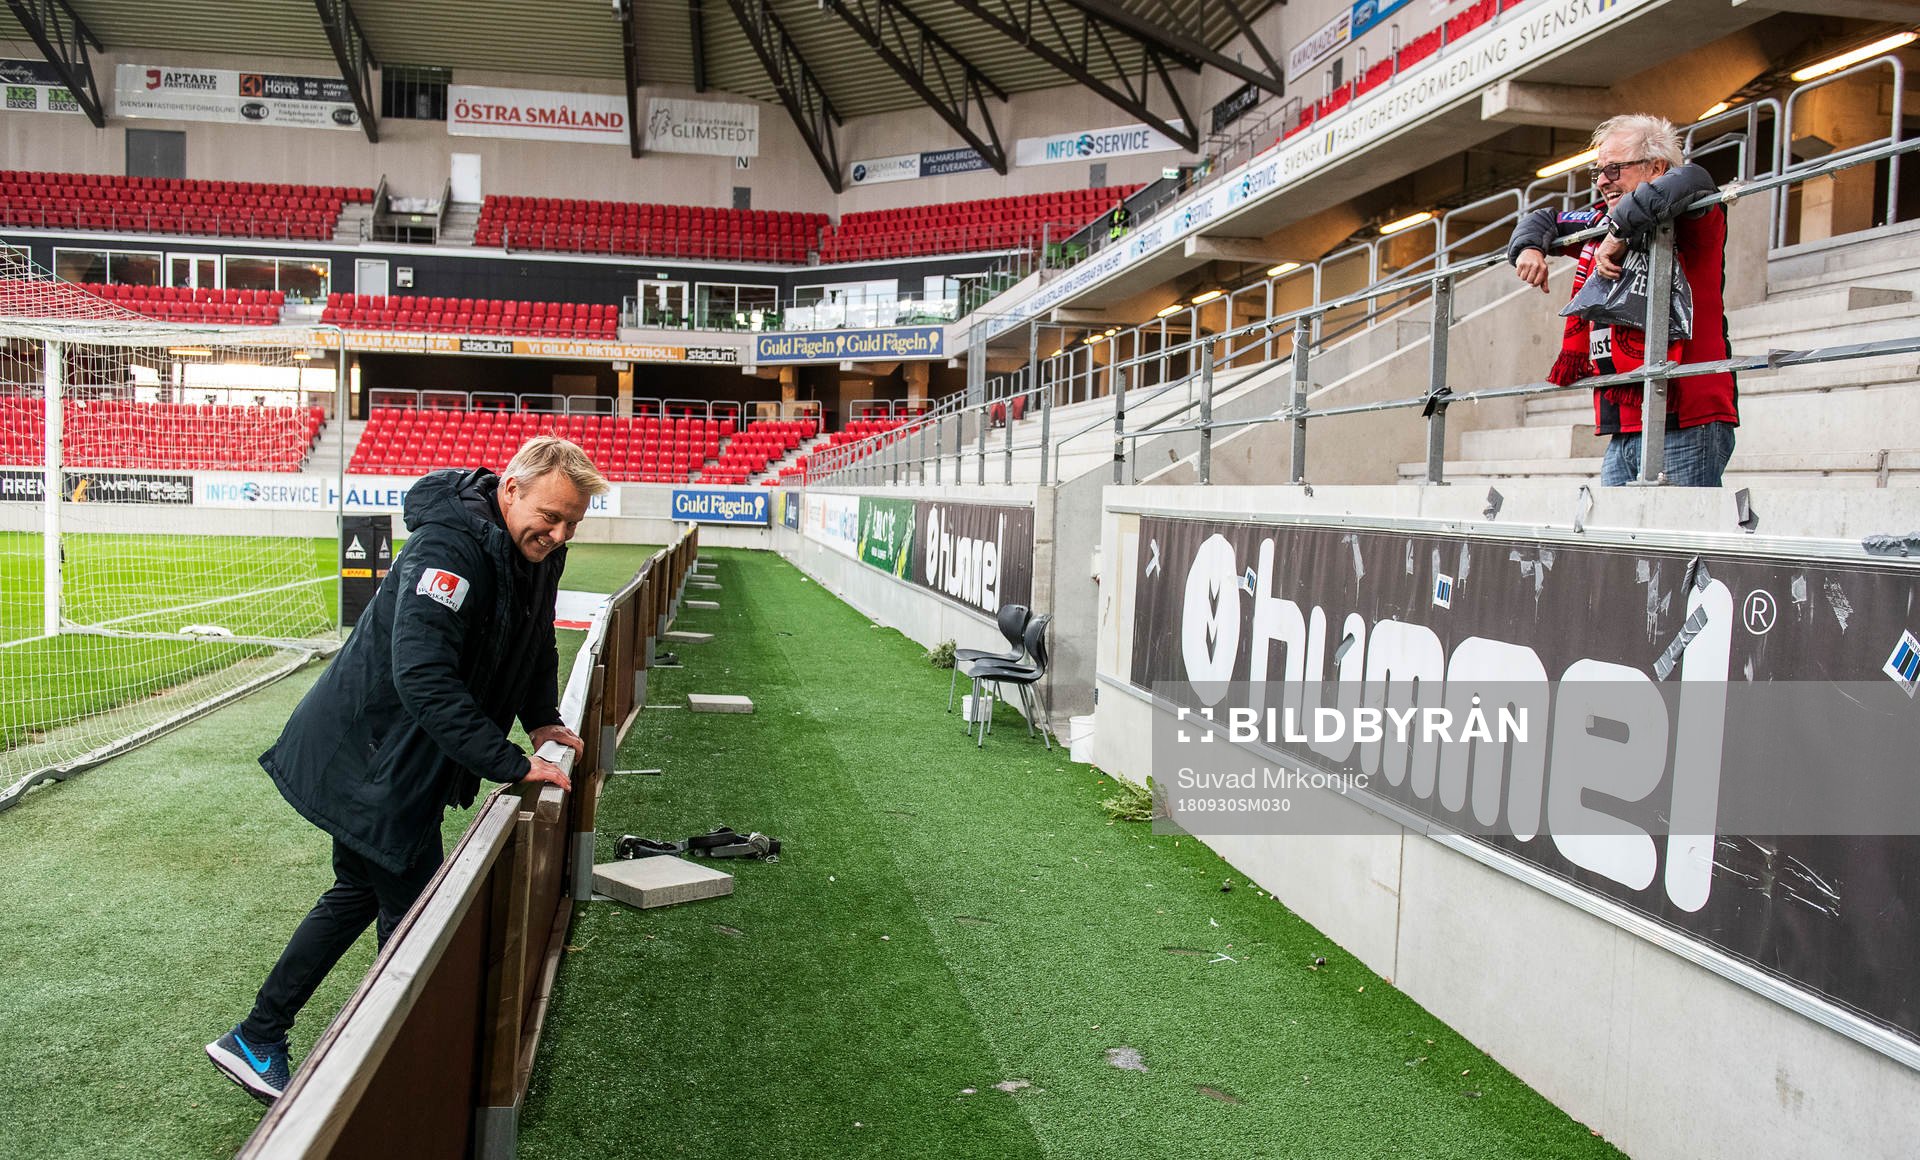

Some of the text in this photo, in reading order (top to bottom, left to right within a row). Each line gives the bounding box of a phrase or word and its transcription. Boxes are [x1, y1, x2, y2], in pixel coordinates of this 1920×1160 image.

[1519, 4, 1591, 51] SVENSK
[164, 72, 217, 85] APTARE
[1337, 37, 1509, 143] FASTIGHETSFÖRMEDLING
[7, 99, 36, 109] BYGG
[50, 102, 78, 111] BYGG
[454, 99, 624, 128] ÖSTRA SMÅLAND
[671, 124, 754, 142] GLIMSTEDT
[1046, 130, 1150, 160] INFO SERVICE
[738, 156, 748, 168] N
[899, 159, 916, 169] NDC
[1285, 139, 1322, 175] SVENSK
[325, 335, 338, 347] VI
[384, 337, 434, 349] KALMAR
[462, 340, 512, 353] stadium
[528, 342, 540, 353] VI
[542, 343, 583, 355] GILLAR
[586, 345, 623, 357] RIKTIG
[761, 335, 835, 358] Guld Fågeln
[847, 332, 928, 353] Guld Fågeln
[687, 348, 735, 362] stadium
[99, 479, 188, 493] wellness
[150, 490, 188, 500] studio
[206, 482, 319, 503] INFO SERVICE
[676, 493, 754, 519] Guld Fågeln
[938, 507, 1004, 614] hummel
[1249, 537, 1734, 912] hummel
